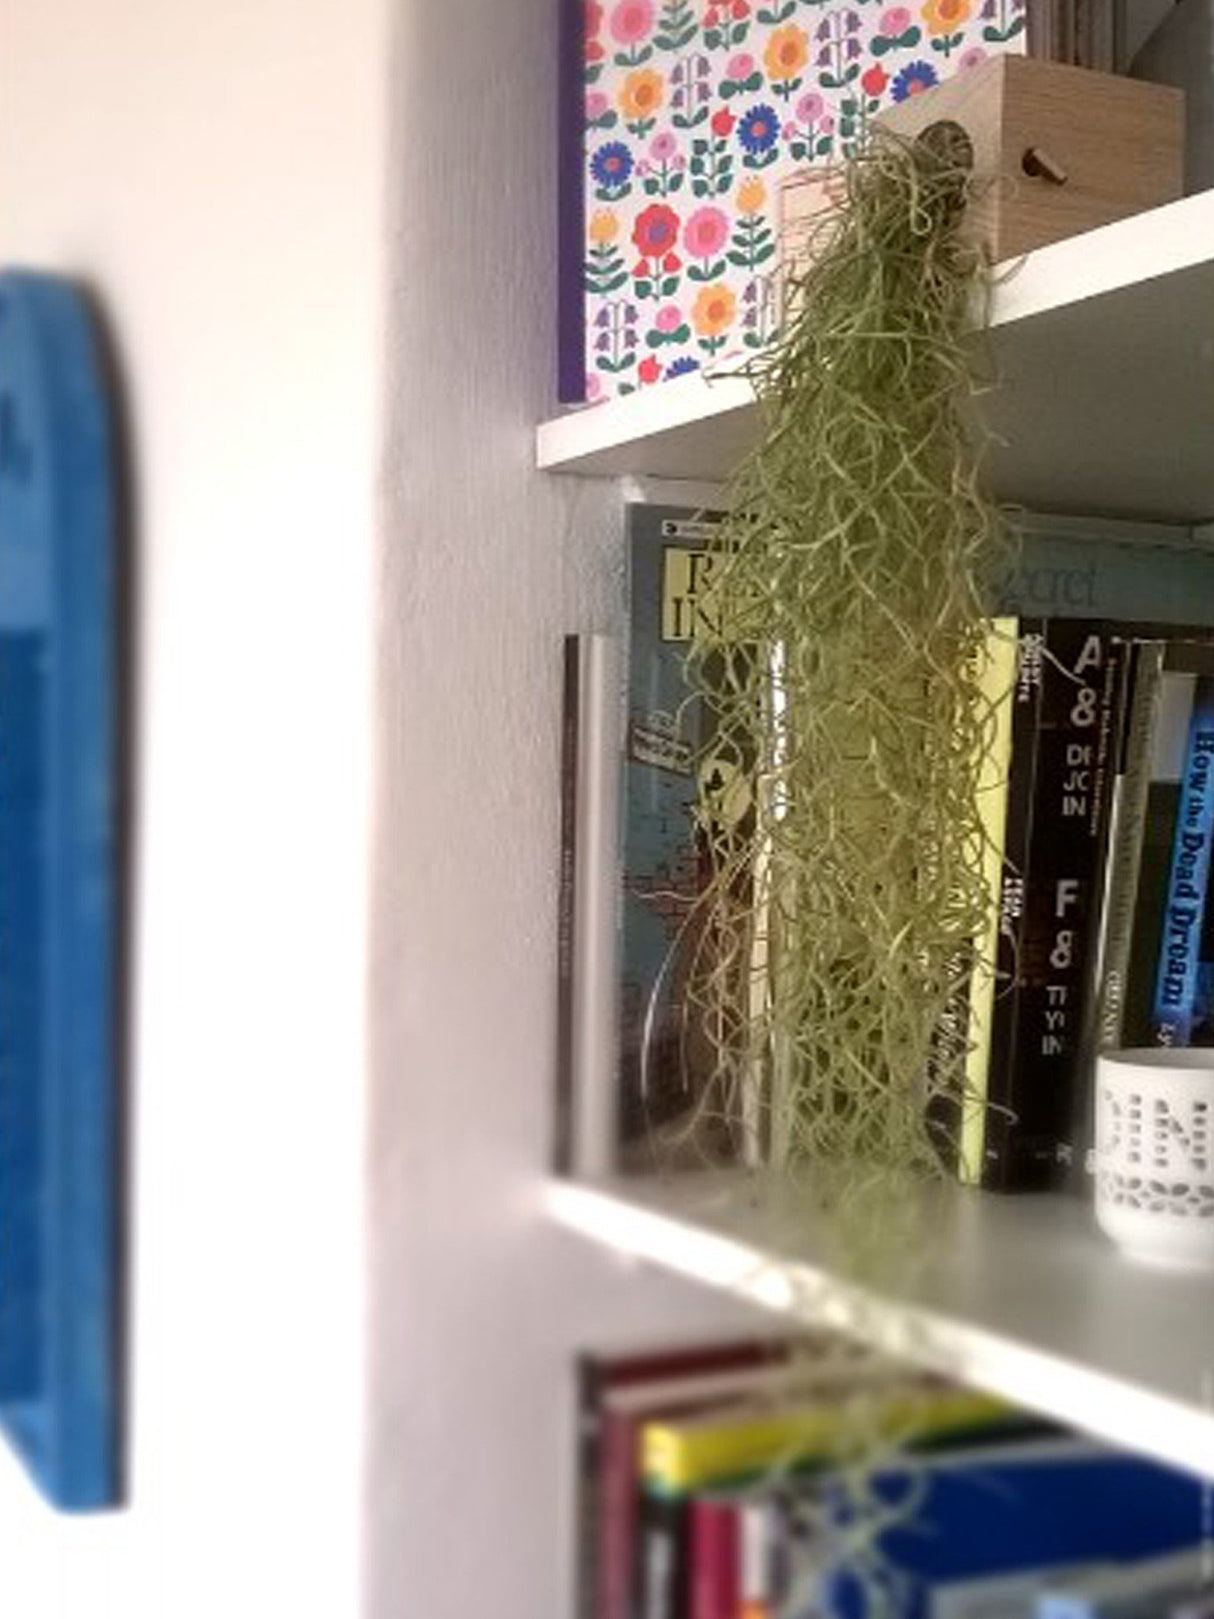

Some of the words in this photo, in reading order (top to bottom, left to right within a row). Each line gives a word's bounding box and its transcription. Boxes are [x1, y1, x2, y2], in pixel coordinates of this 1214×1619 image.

[1074, 635, 1100, 674] A
[1070, 687, 1097, 727] &
[1189, 730, 1214, 793] How
[1186, 796, 1205, 827] the
[1174, 832, 1205, 900] Dead
[1055, 879, 1079, 917] F
[1050, 930, 1074, 969] &
[1161, 905, 1198, 1006] Dream
